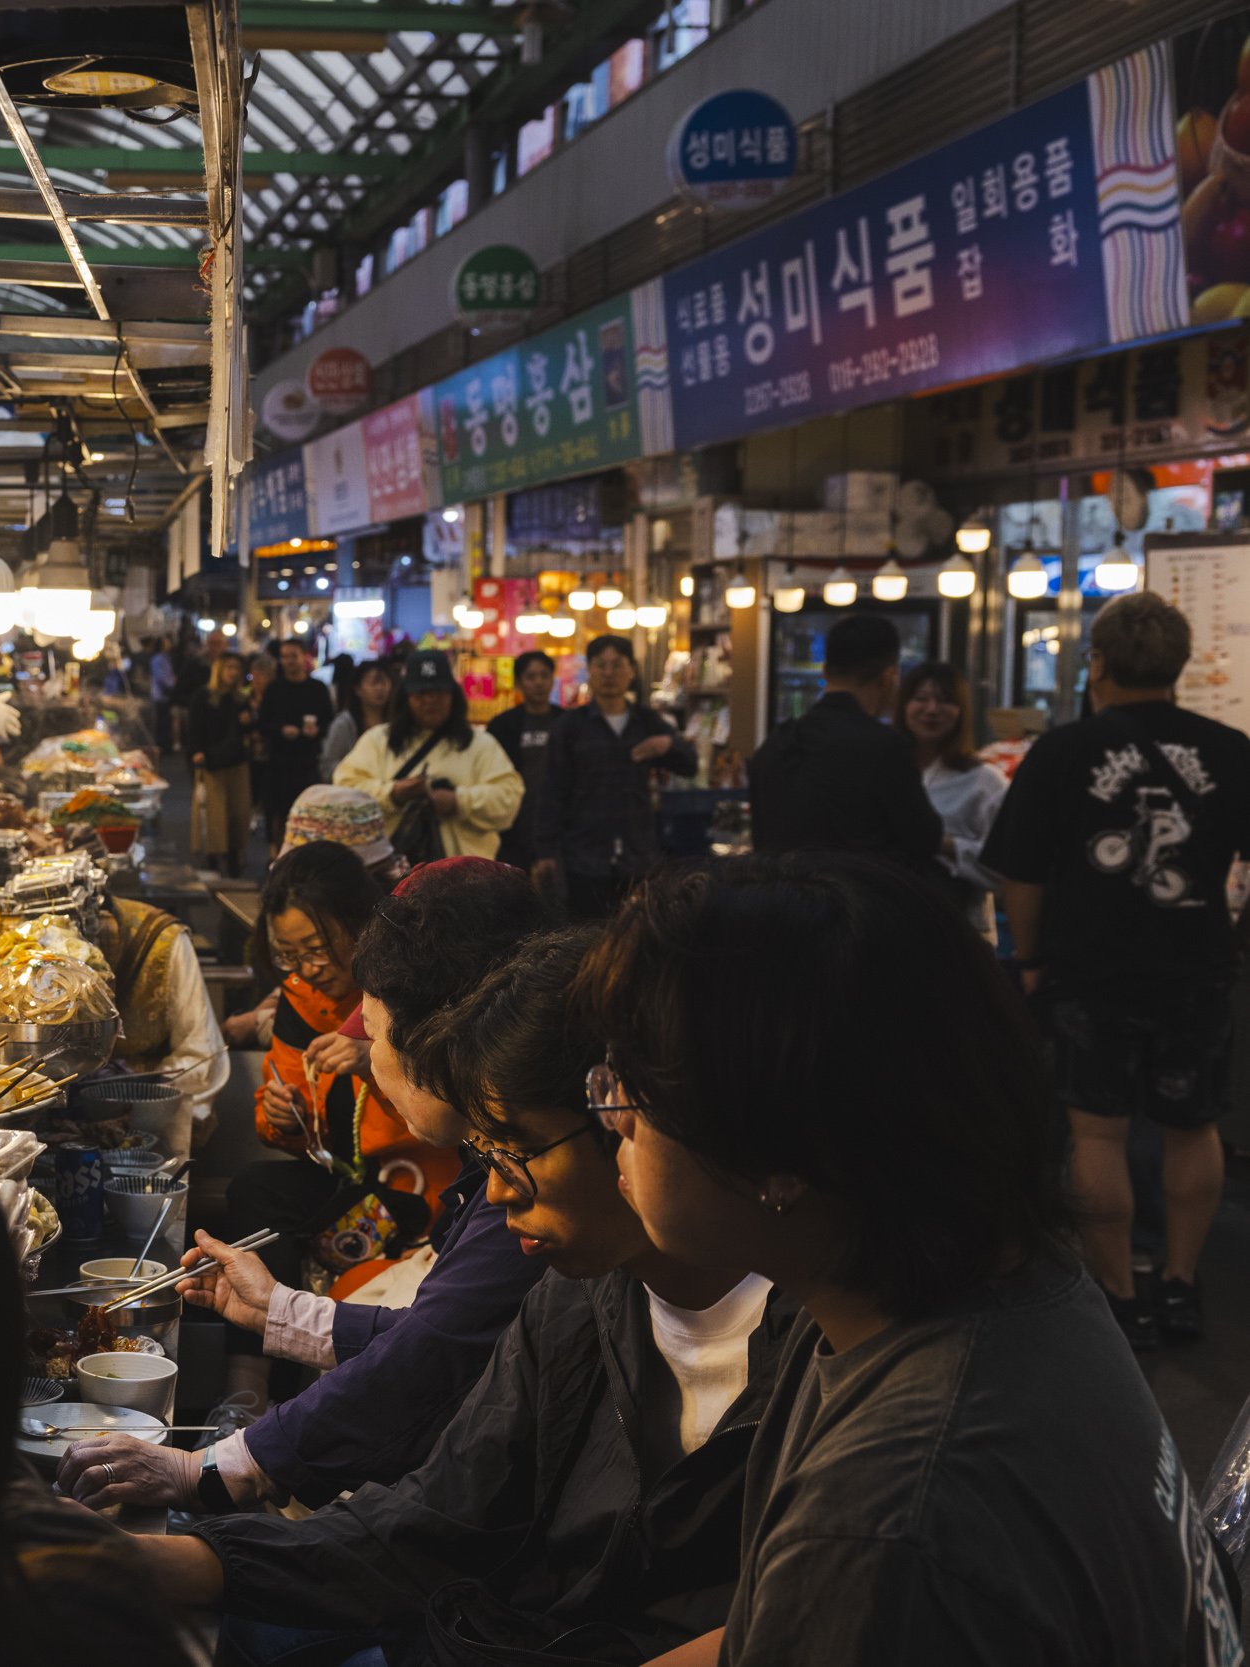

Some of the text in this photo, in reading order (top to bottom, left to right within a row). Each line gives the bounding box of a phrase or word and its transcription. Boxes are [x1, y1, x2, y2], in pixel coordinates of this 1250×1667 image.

[686, 126, 788, 170] 성미식품
[951, 136, 1074, 235] 일회용품
[737, 194, 936, 366] 성미식품
